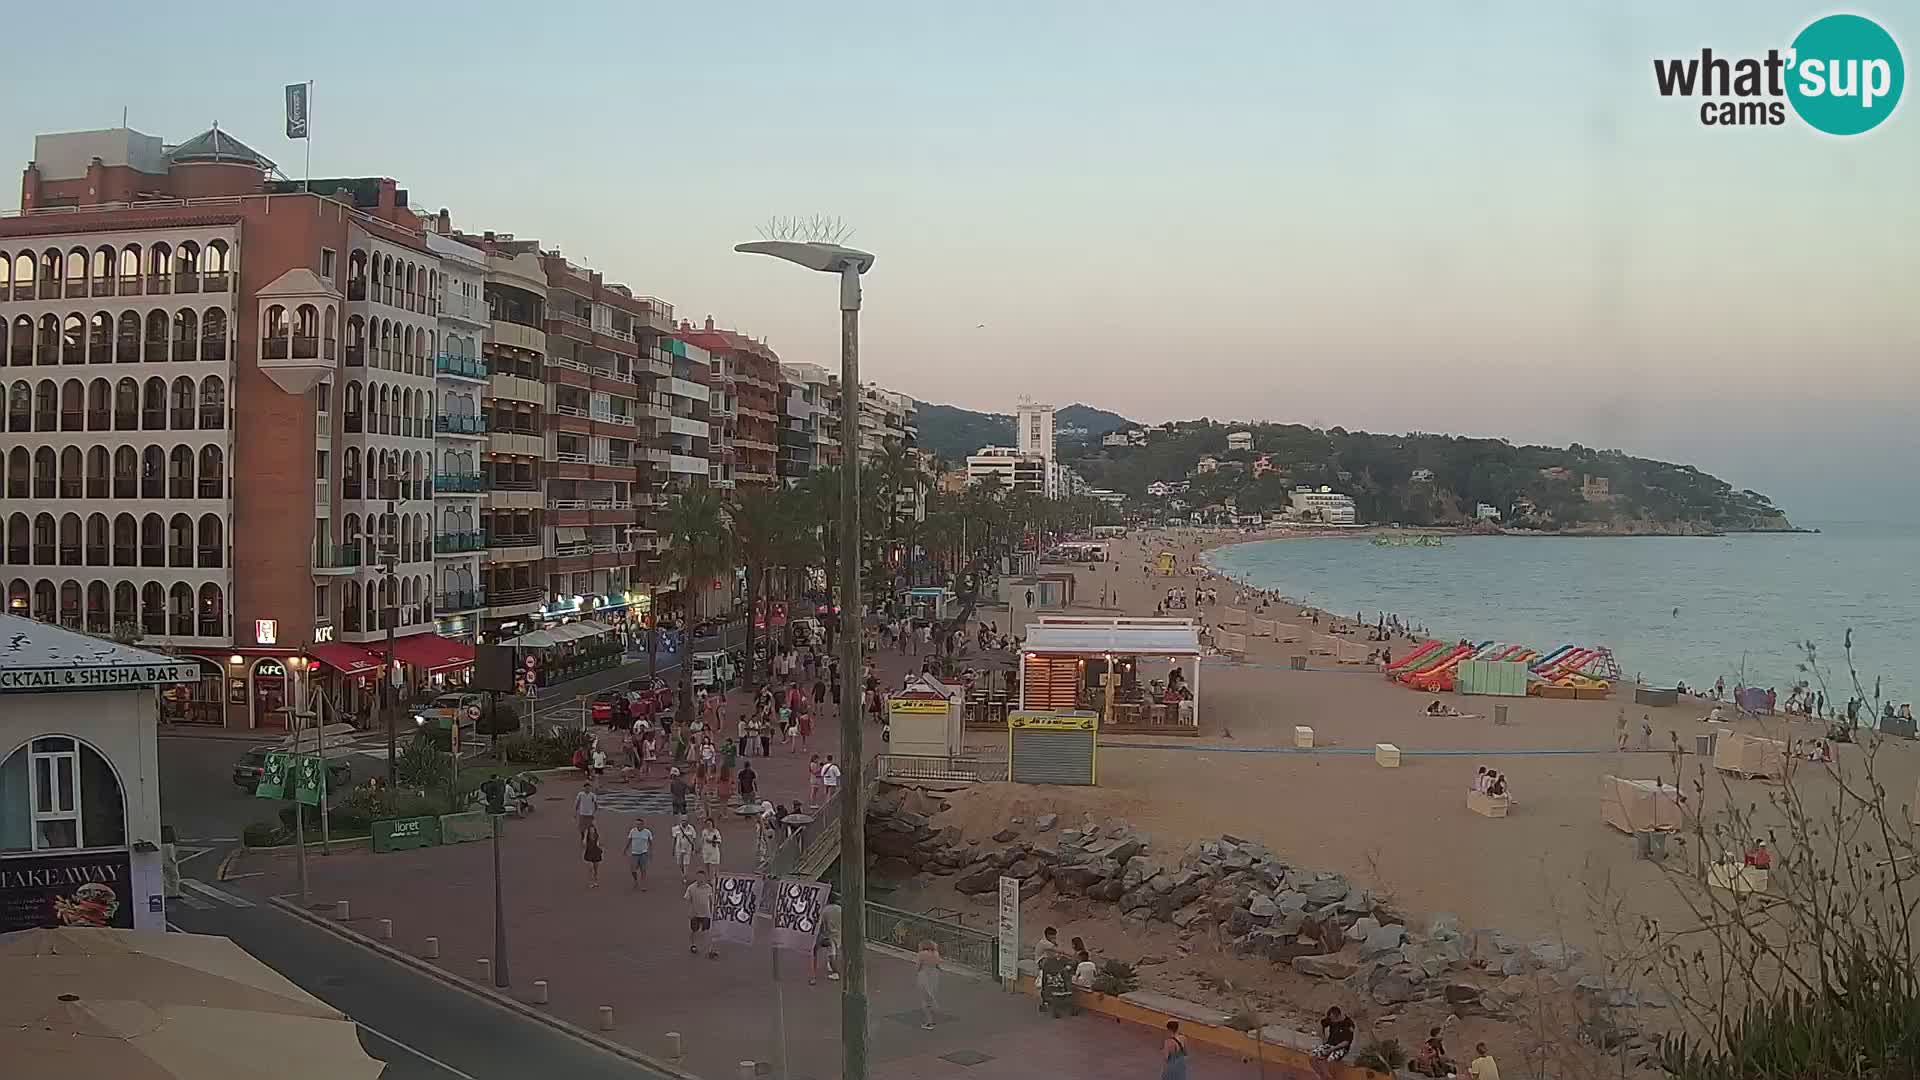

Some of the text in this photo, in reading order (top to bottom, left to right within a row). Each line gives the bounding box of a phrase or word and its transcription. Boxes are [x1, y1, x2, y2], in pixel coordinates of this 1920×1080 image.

[314, 626, 334, 644] KFC
[64, 671, 76, 684] &
[79, 668, 143, 684] SHISHA
[146, 667, 179, 681] BAR
[259, 665, 283, 676] KFC
[394, 820, 420, 833] lloret
